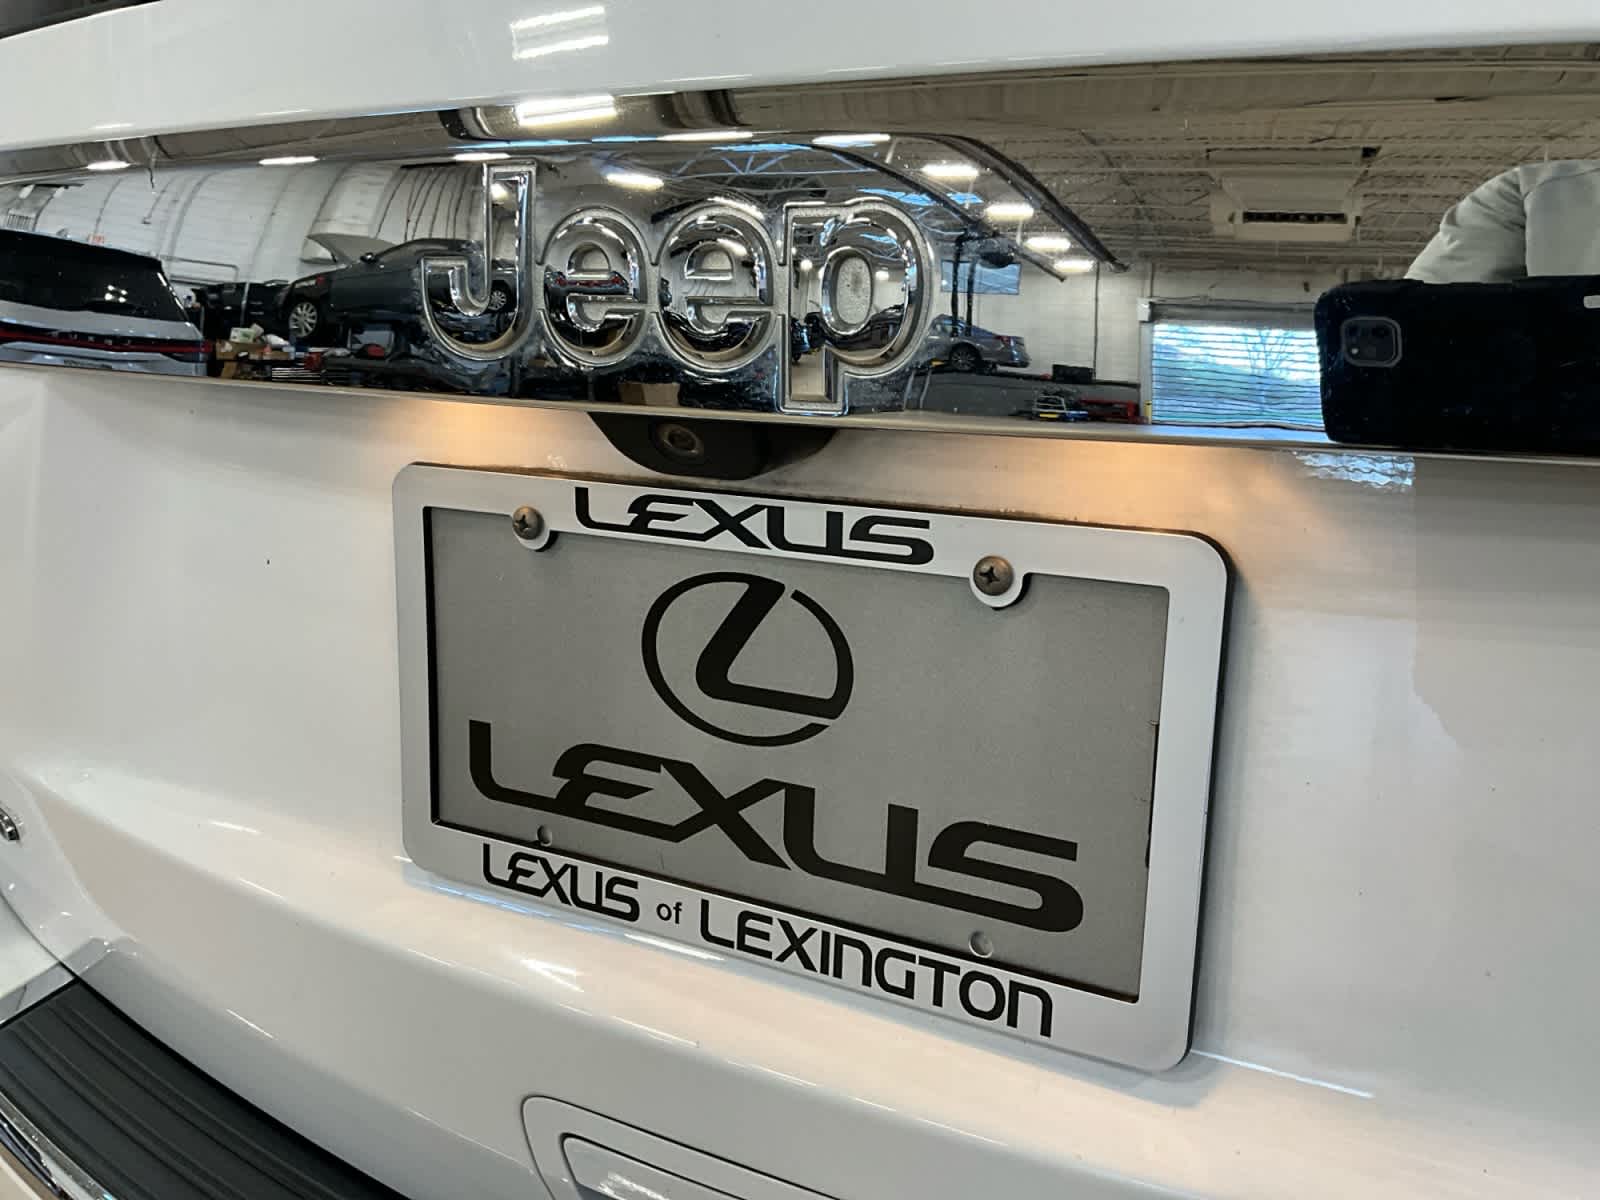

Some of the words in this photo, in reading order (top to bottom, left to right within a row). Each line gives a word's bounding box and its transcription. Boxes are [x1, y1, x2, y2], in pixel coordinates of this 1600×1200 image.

[421, 161, 934, 414] Jeep
[575, 487, 934, 564] LEXUS
[469, 720, 1083, 932] LEXUS
[483, 843, 639, 921] LEXUS
[656, 901, 683, 925] of
[701, 899, 1052, 1037] LEXINGTON
